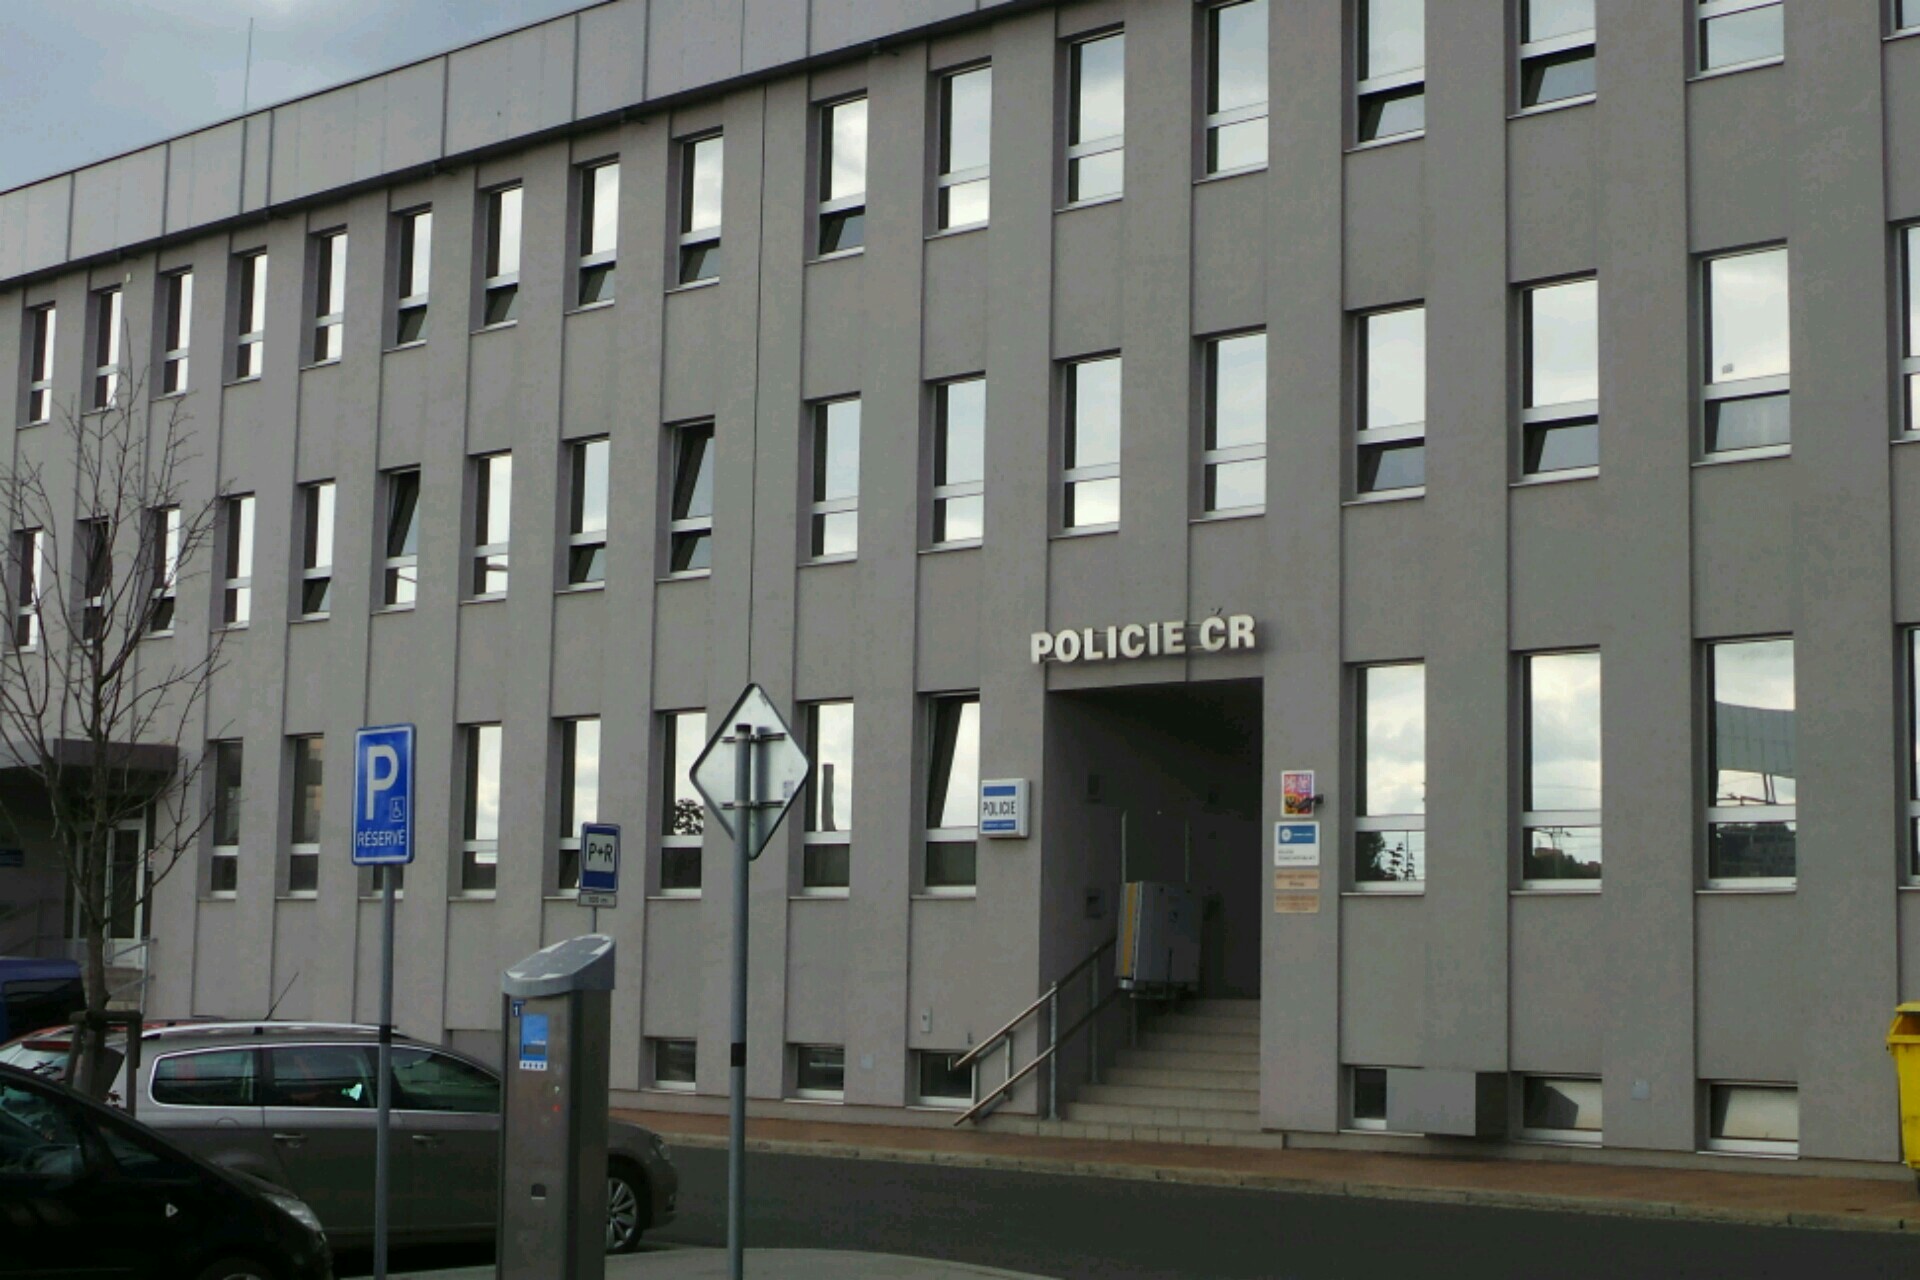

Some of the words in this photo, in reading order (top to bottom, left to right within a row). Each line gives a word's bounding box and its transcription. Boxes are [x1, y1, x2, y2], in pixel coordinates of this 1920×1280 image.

[1031, 620, 1187, 664] POLICIE
[366, 745, 399, 821] P
[983, 801, 1016, 816] POLICIE
[588, 842, 613, 862] P+R
